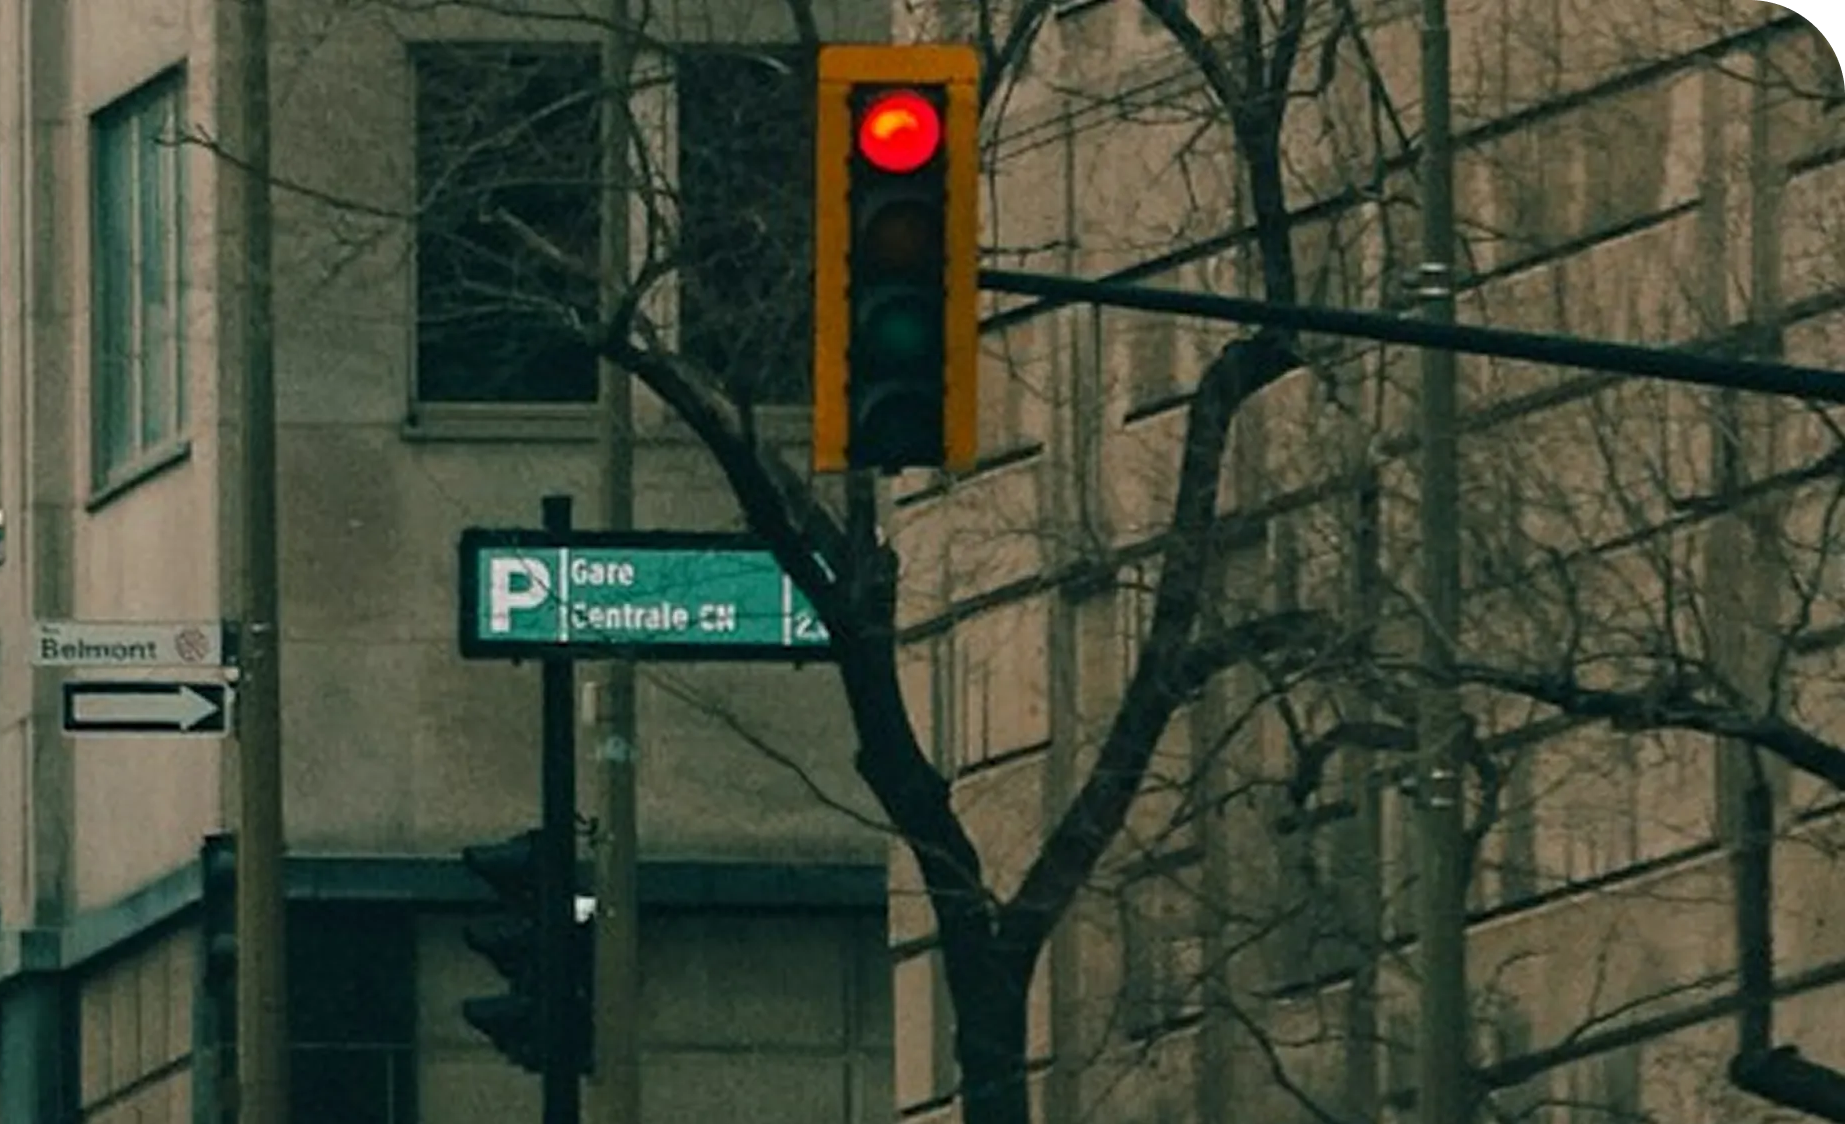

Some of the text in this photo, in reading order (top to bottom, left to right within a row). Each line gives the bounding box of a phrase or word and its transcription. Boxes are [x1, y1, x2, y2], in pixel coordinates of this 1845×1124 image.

[571, 558, 635, 585] Gare
[490, 557, 550, 632] P
[571, 602, 689, 631] Centrale
[41, 638, 157, 660] Belmont
